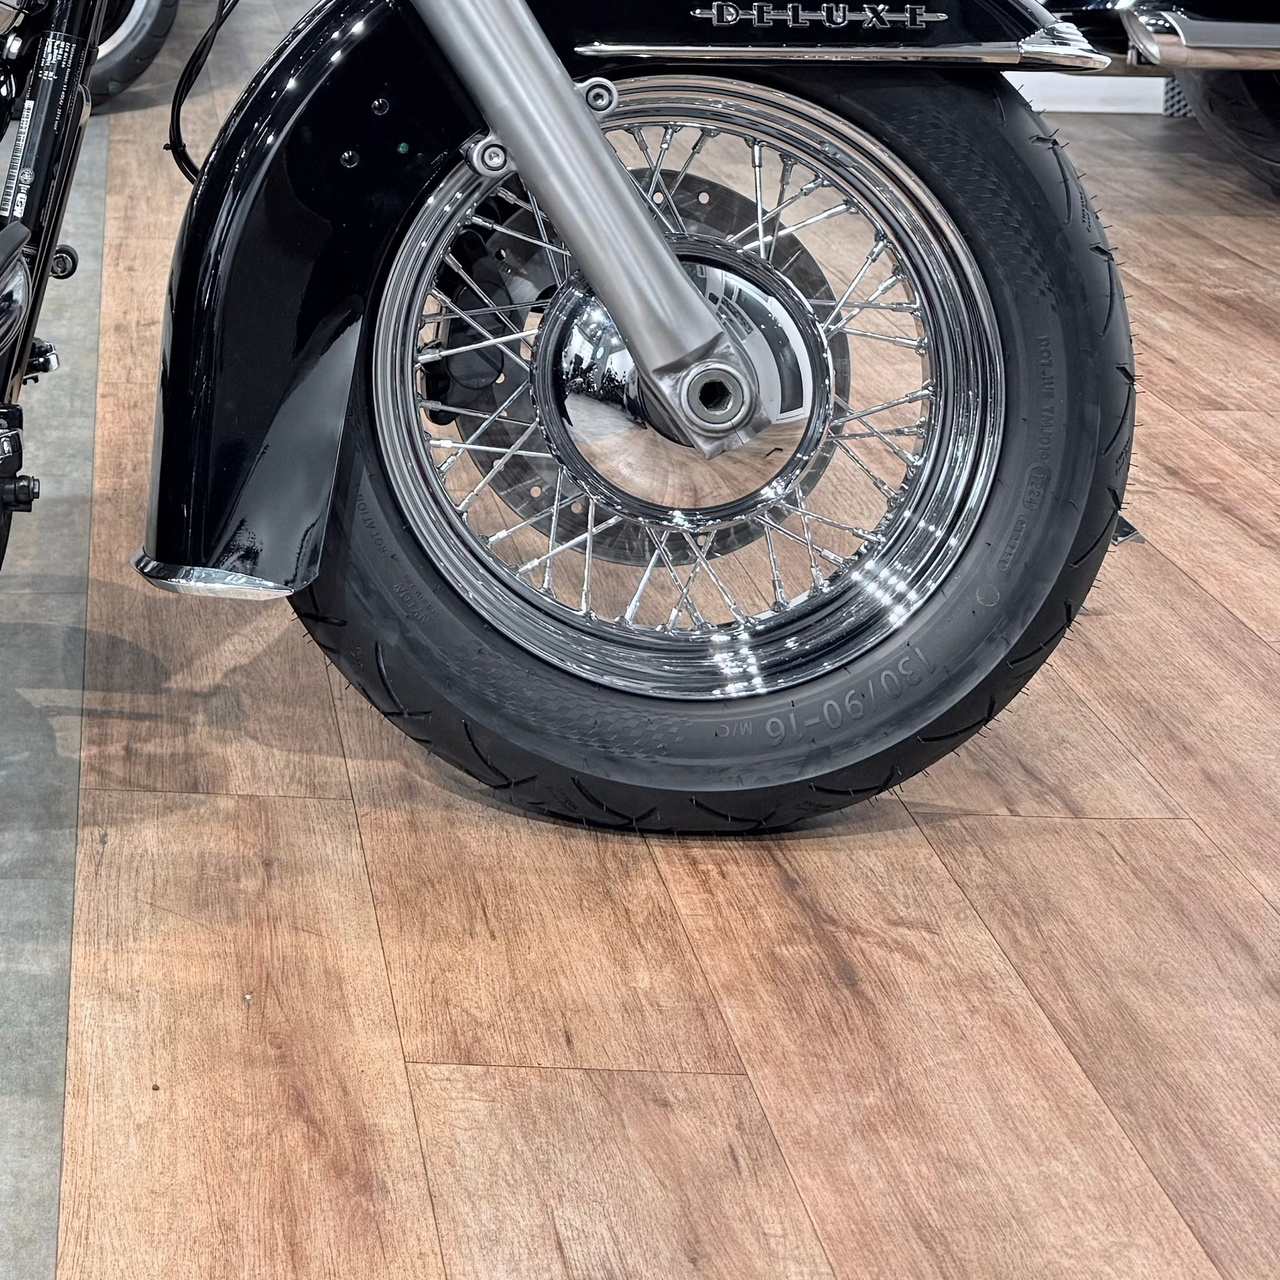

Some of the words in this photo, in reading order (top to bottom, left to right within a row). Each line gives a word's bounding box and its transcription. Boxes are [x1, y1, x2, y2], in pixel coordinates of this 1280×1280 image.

[712, 2, 926, 29] DELUXE
[765, 646, 934, 747] 130/90-16
[720, 721, 752, 737] M/C
